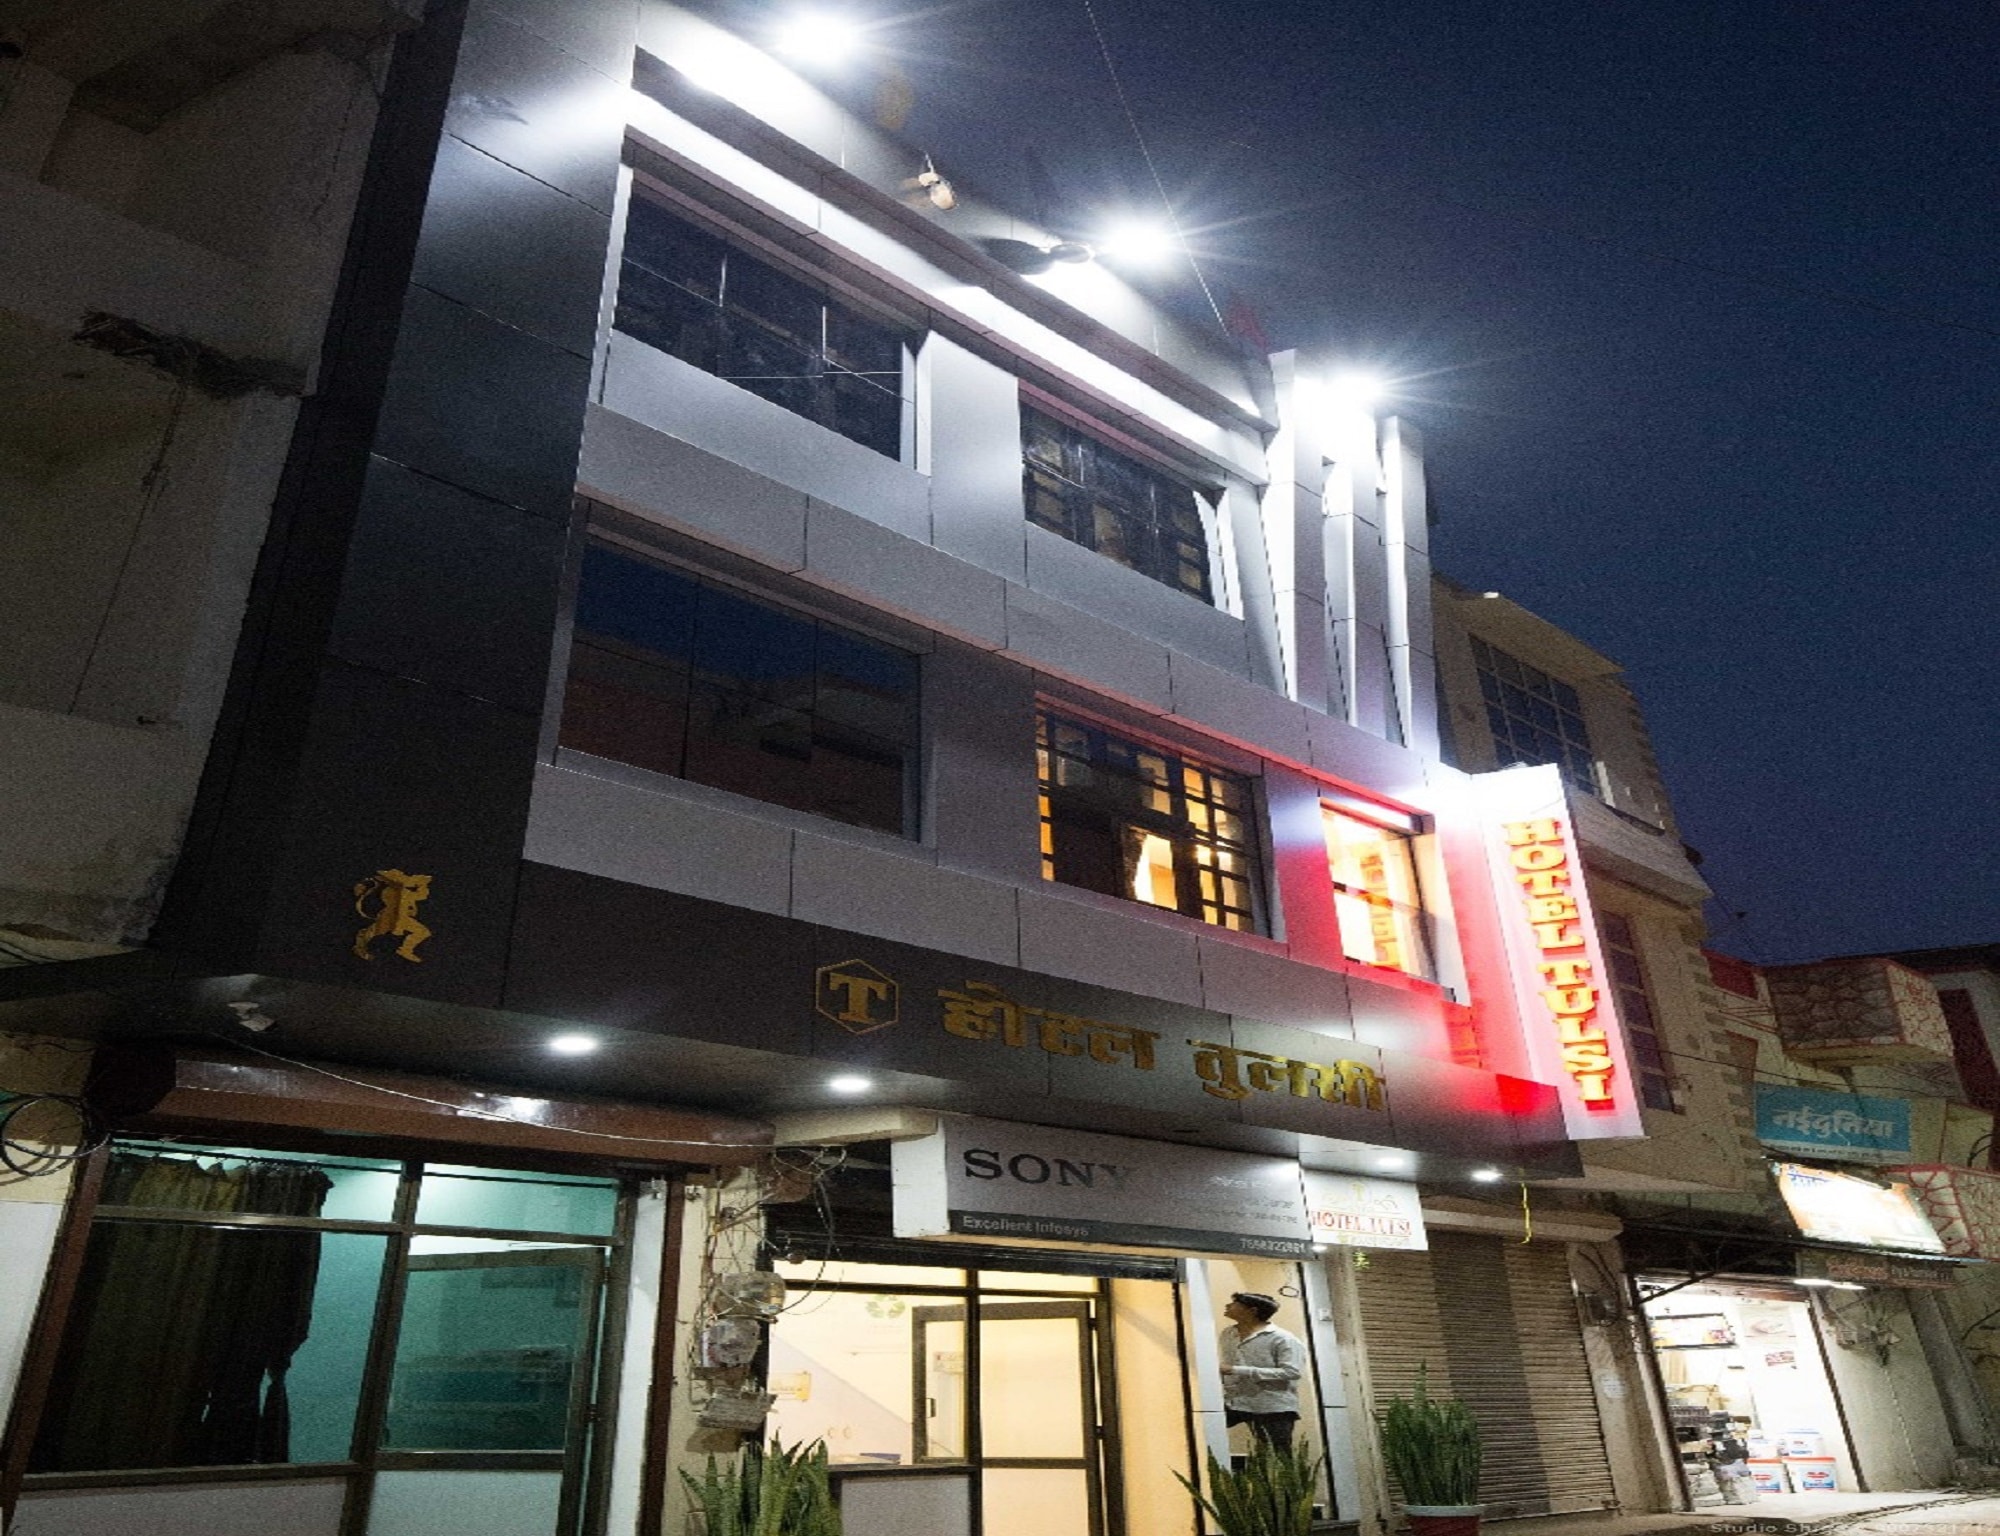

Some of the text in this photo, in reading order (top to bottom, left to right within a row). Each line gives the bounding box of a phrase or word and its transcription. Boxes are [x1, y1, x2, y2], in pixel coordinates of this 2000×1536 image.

[1503, 818, 1615, 1106] HOTEL TULSI
[829, 973, 888, 1023] T
[937, 980, 1388, 1112] होटल तुलसी
[963, 1148, 1134, 1191] SONY
[1311, 1210, 1365, 1231] HOTEL
